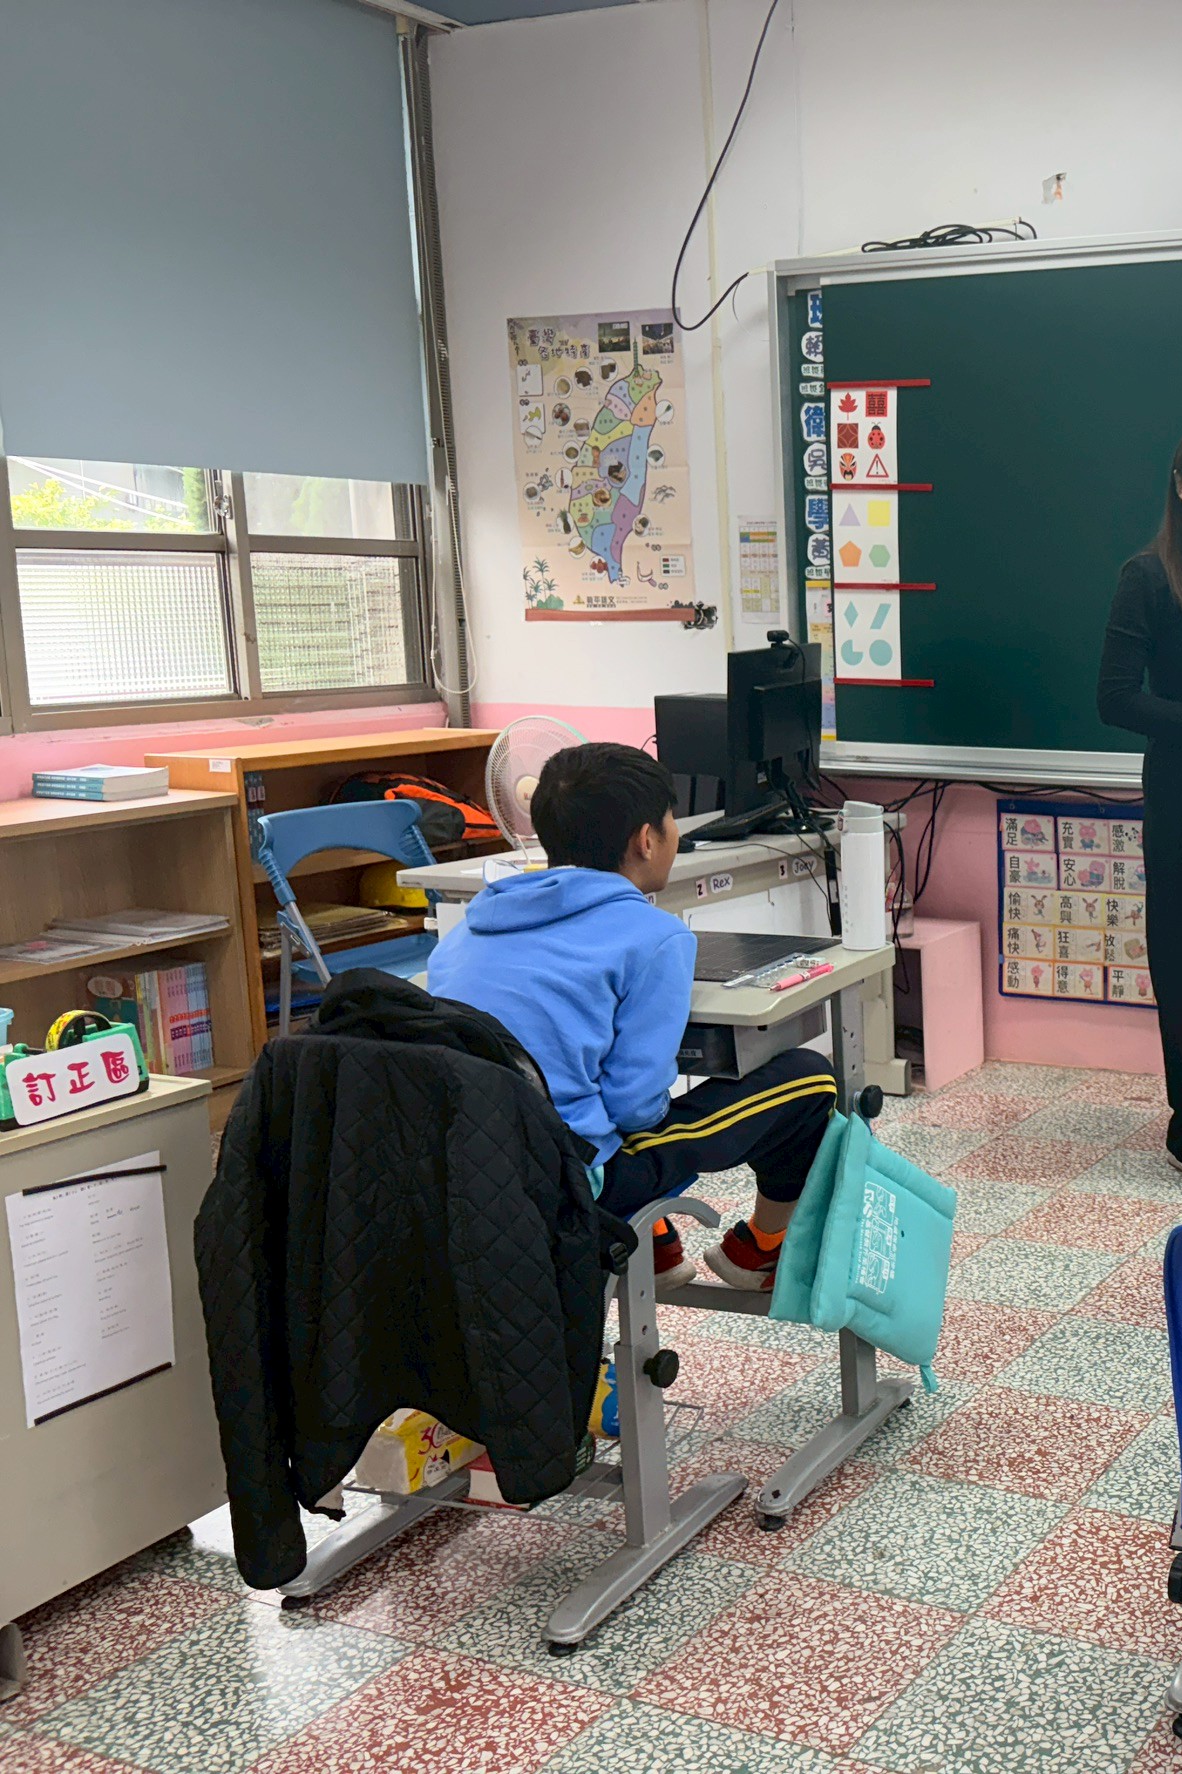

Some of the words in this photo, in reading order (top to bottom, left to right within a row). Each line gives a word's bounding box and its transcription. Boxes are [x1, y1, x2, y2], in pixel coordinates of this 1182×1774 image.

[1005, 817, 1018, 846] 滿足
[1061, 821, 1075, 850] 充實
[1111, 824, 1125, 853] 感激
[713, 876, 731, 890] Rex
[1009, 855, 1022, 884] 自豪
[1063, 858, 1077, 887] 安心
[1112, 861, 1126, 891] 解脫
[1008, 892, 1021, 921] 愉快
[1059, 895, 1073, 924] 高興
[1106, 899, 1119, 928] 快樂
[1007, 927, 1020, 955] 痛快
[1057, 931, 1070, 959] 狂喜
[1006, 961, 1020, 989] 感動
[1056, 965, 1069, 994] 得意
[1111, 969, 1125, 999] 平靜
[22, 1051, 130, 1106] 訂正區
